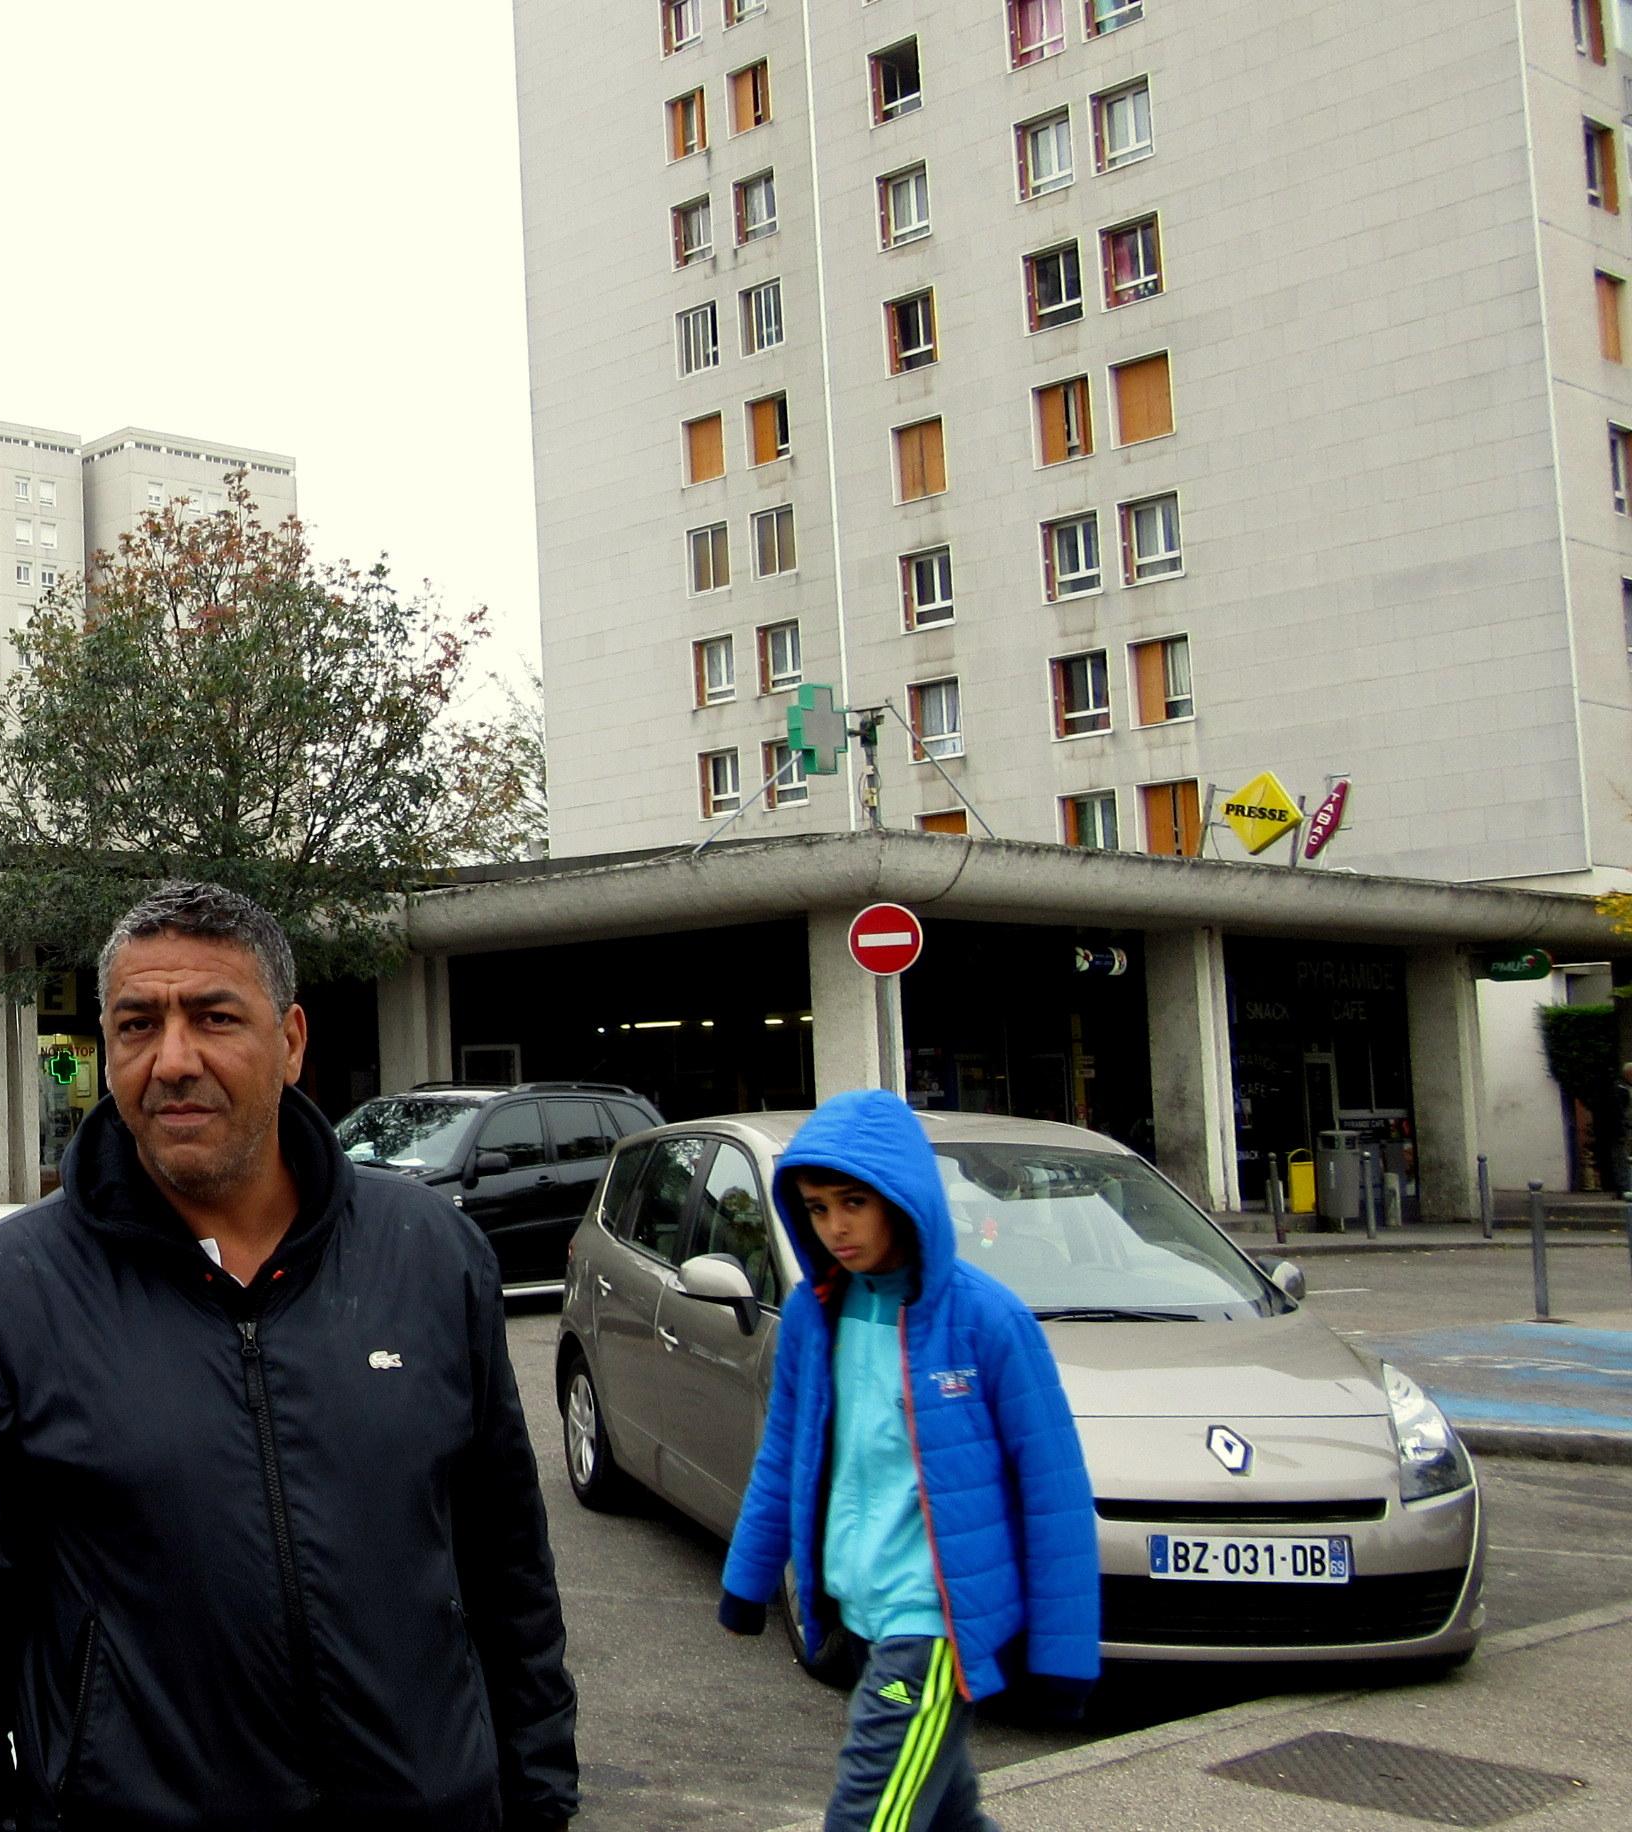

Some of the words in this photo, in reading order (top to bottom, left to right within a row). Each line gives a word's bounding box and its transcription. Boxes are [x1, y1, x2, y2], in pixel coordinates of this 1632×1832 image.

[1225, 803, 1289, 822] PRESSE
[1309, 793, 1340, 845] TABAC
[1246, 1000, 1289, 1021] SNACK
[1172, 1540, 1326, 1578] BZ-031-DB
[1330, 1559, 1346, 1576] 69
